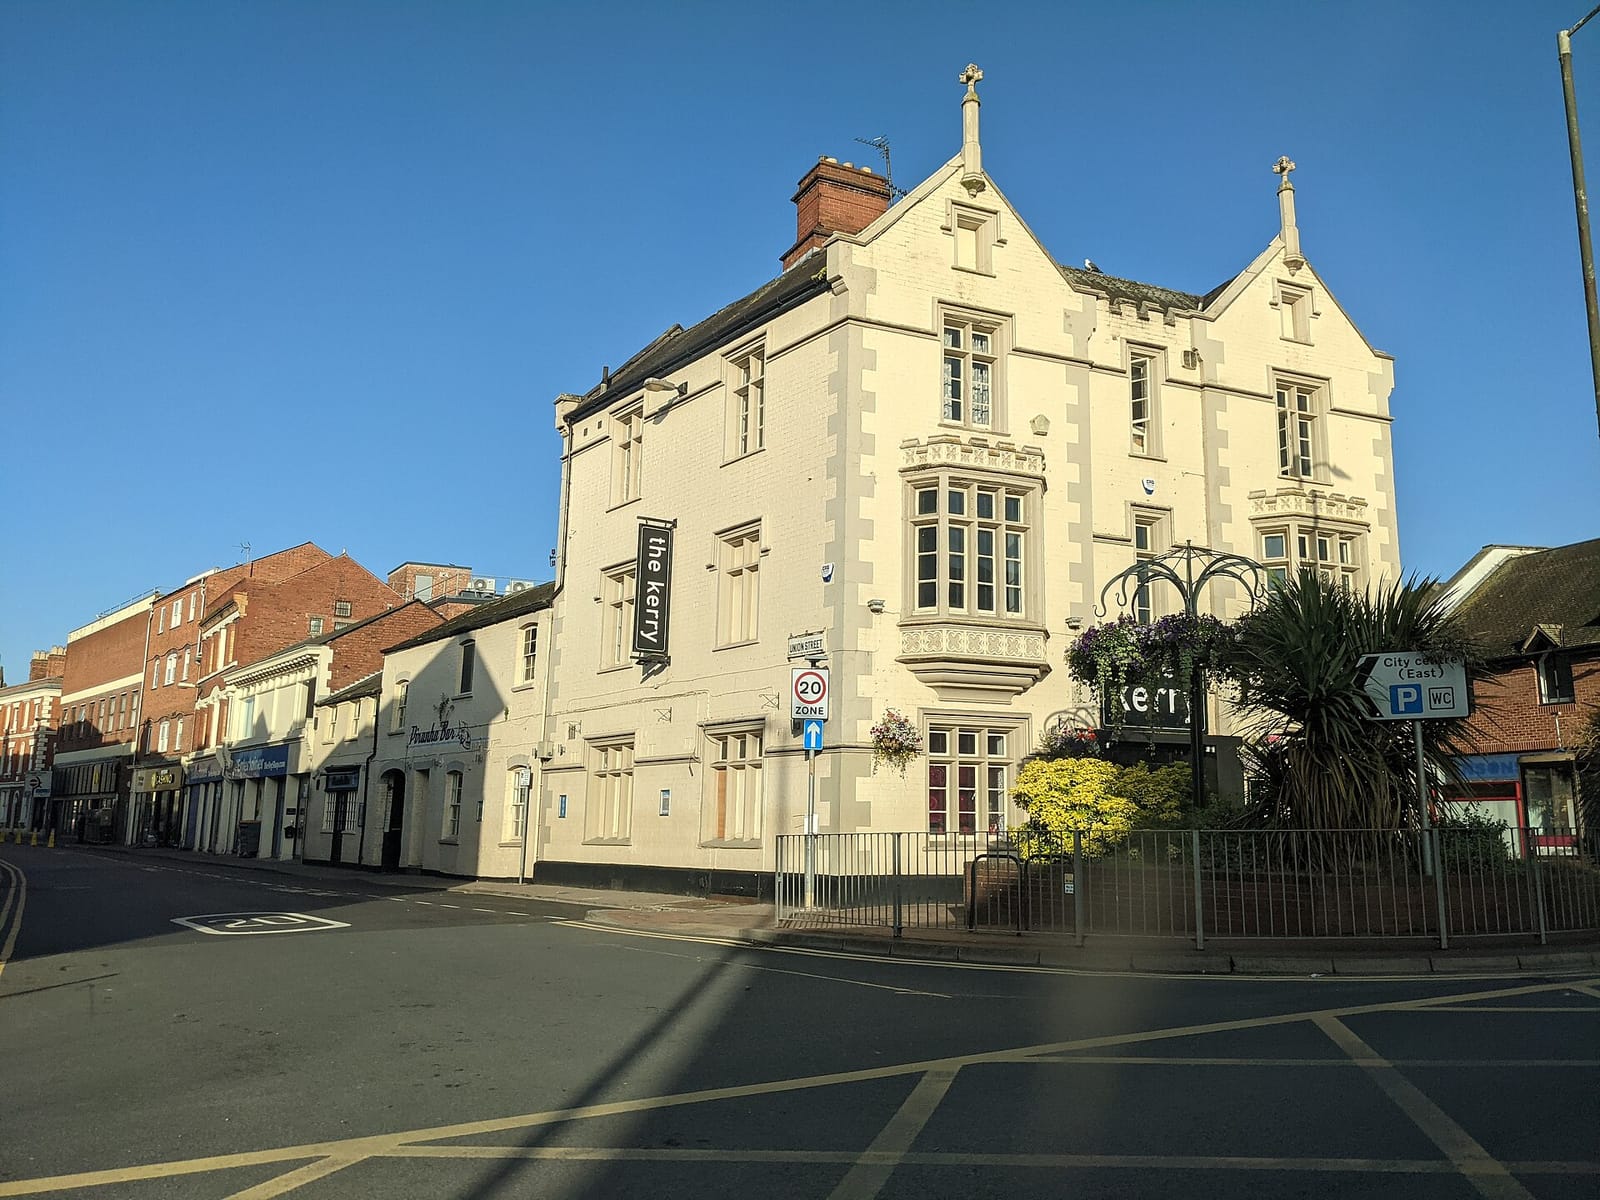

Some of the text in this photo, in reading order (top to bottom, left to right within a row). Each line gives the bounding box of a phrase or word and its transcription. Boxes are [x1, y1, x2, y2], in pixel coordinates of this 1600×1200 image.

[640, 537, 667, 644] the kerry
[789, 639, 823, 653] UNION STREET
[1384, 657, 1410, 668] City
[1398, 667, 1444, 680] (East)
[799, 681, 822, 695] 20
[1397, 687, 1418, 712] P
[1431, 692, 1452, 705] WC
[795, 706, 825, 715] ZONE
[409, 720, 456, 745] Piranha Bar
[208, 915, 307, 928] 20
